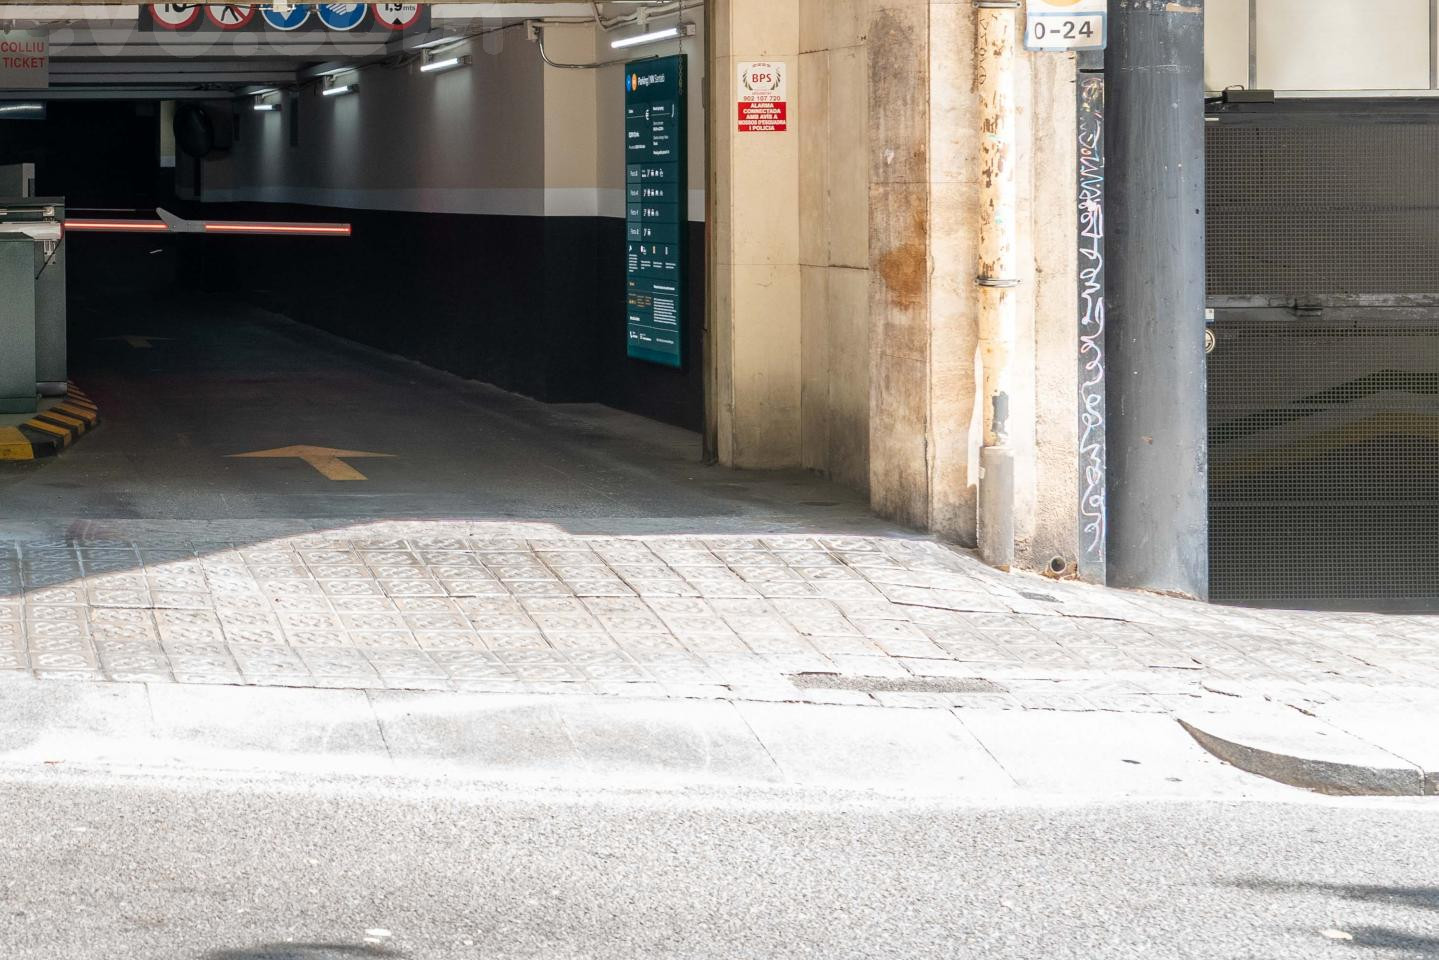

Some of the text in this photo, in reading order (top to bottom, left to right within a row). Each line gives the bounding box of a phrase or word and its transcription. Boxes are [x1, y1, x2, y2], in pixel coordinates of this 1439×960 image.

[1034, 21, 1094, 40] 0-24
[3, 56, 46, 68] TICKET
[752, 74, 772, 83] BPS
